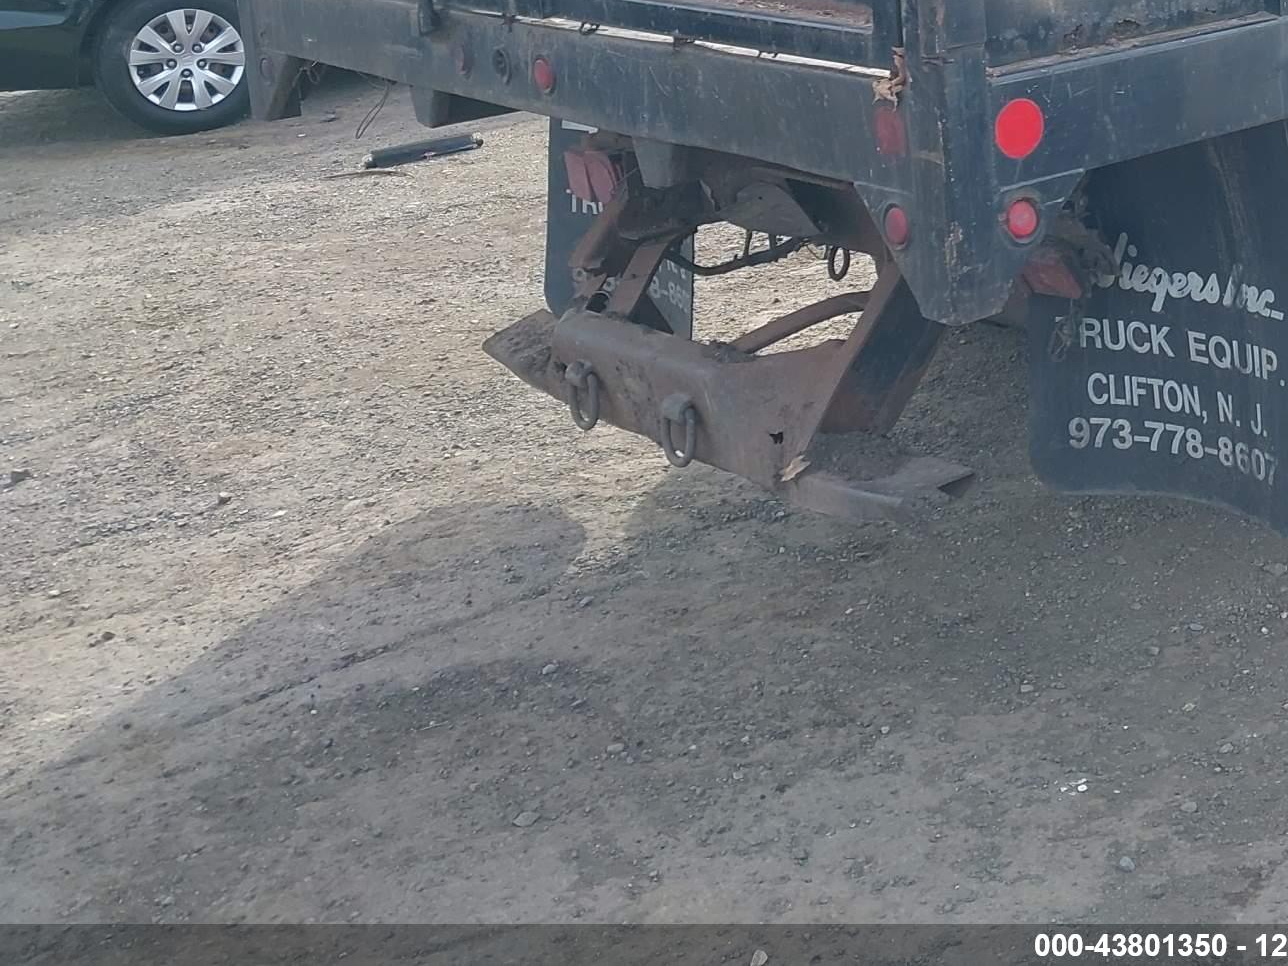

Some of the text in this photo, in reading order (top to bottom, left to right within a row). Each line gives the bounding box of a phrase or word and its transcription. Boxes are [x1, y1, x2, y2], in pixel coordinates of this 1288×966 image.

[1187, 330, 1286, 387] EQUIP.
[1087, 372, 1268, 437] CLIFTON, N. J.
[1068, 417, 1279, 485] 973-778-8607
